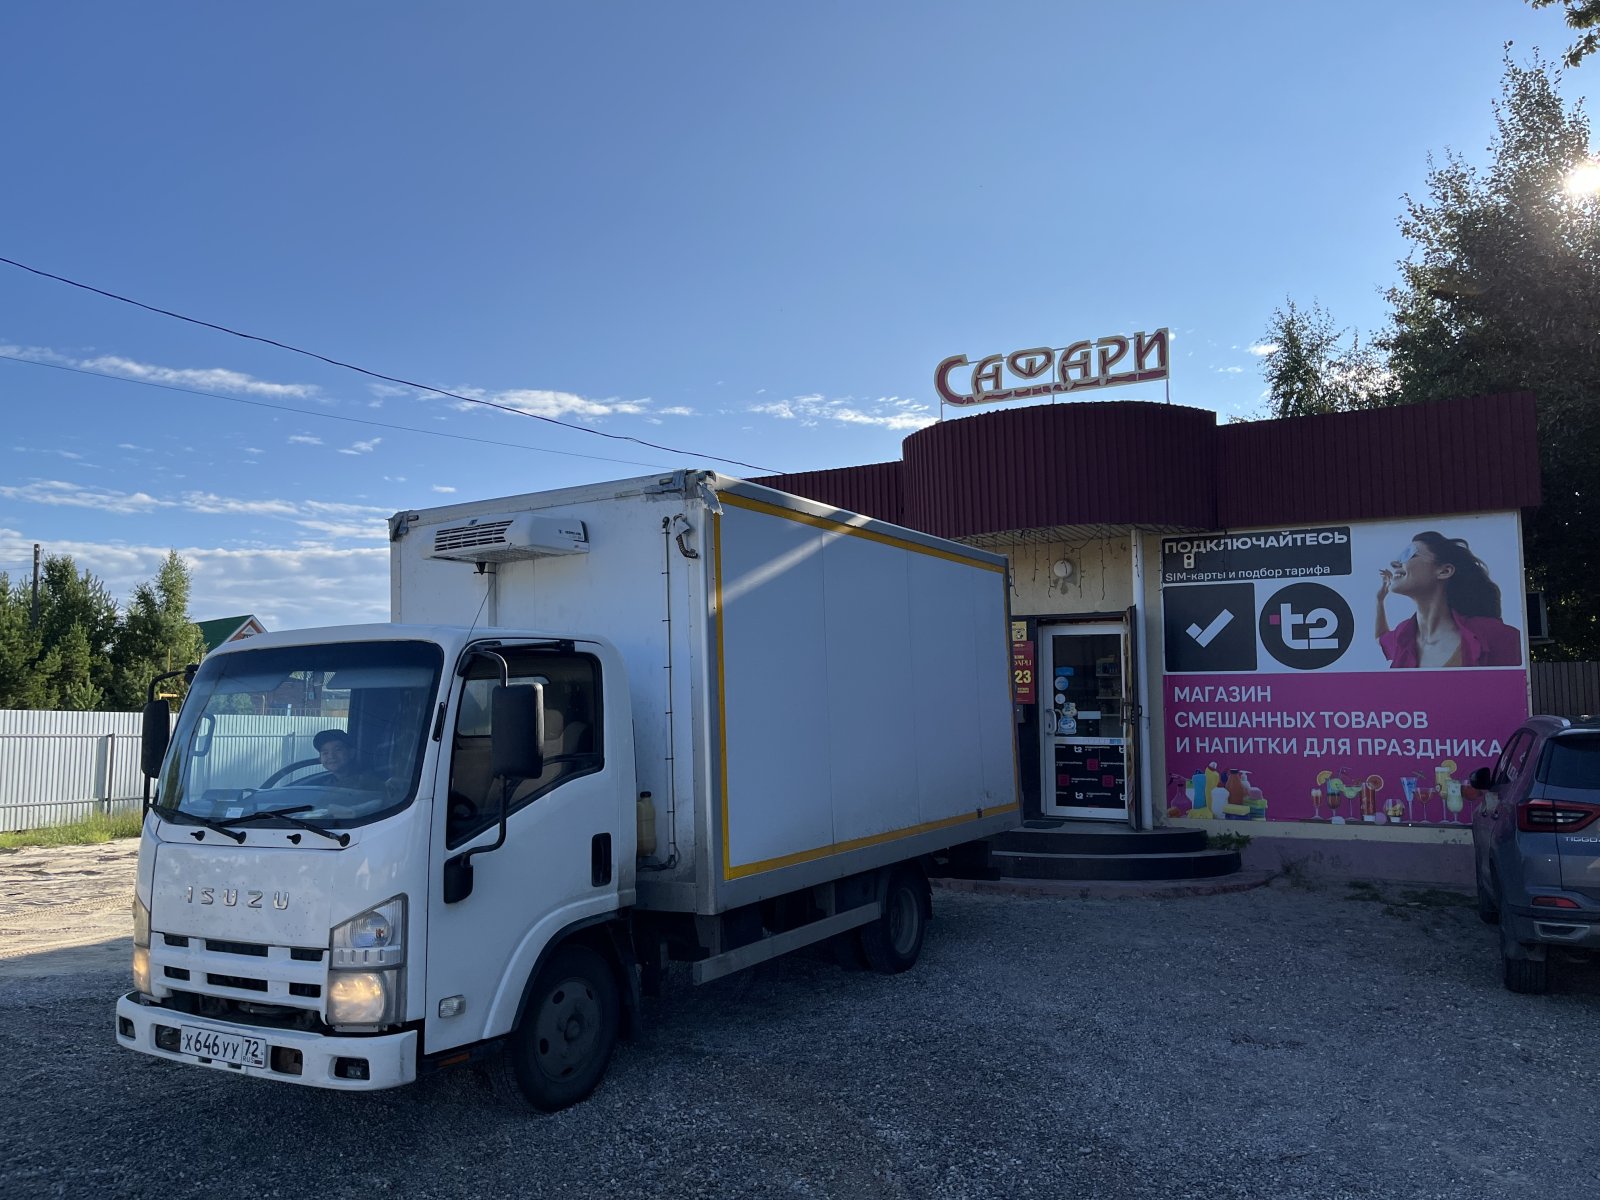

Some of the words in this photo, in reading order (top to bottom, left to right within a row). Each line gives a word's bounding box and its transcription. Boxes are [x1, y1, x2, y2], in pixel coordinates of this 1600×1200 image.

[934, 328, 1169, 407] САФАРИ
[1164, 531, 1348, 555] ПОДКЛЮЧАЙТЕСЬ
[1165, 571, 1226, 582] SIM-карты
[1238, 567, 1283, 580] подбор
[1284, 564, 1331, 577] тарифа
[1269, 603, 1339, 650] t2
[1014, 670, 1032, 684] 23
[1174, 685, 1272, 703] МАГАЗИН
[1174, 711, 1316, 729] СМЕШАННЫХ
[1319, 711, 1429, 729] ТОВАРОВ
[1176, 736, 1190, 753] И
[1195, 737, 1297, 754] НАПИТКИ
[1303, 737, 1351, 758] ДЛЯ
[1357, 738, 1503, 760] ПРАЗДНИКА
[187, 886, 290, 910] ISUZU
[244, 1038, 259, 1058] 72
[242, 1055, 255, 1064] RUS
